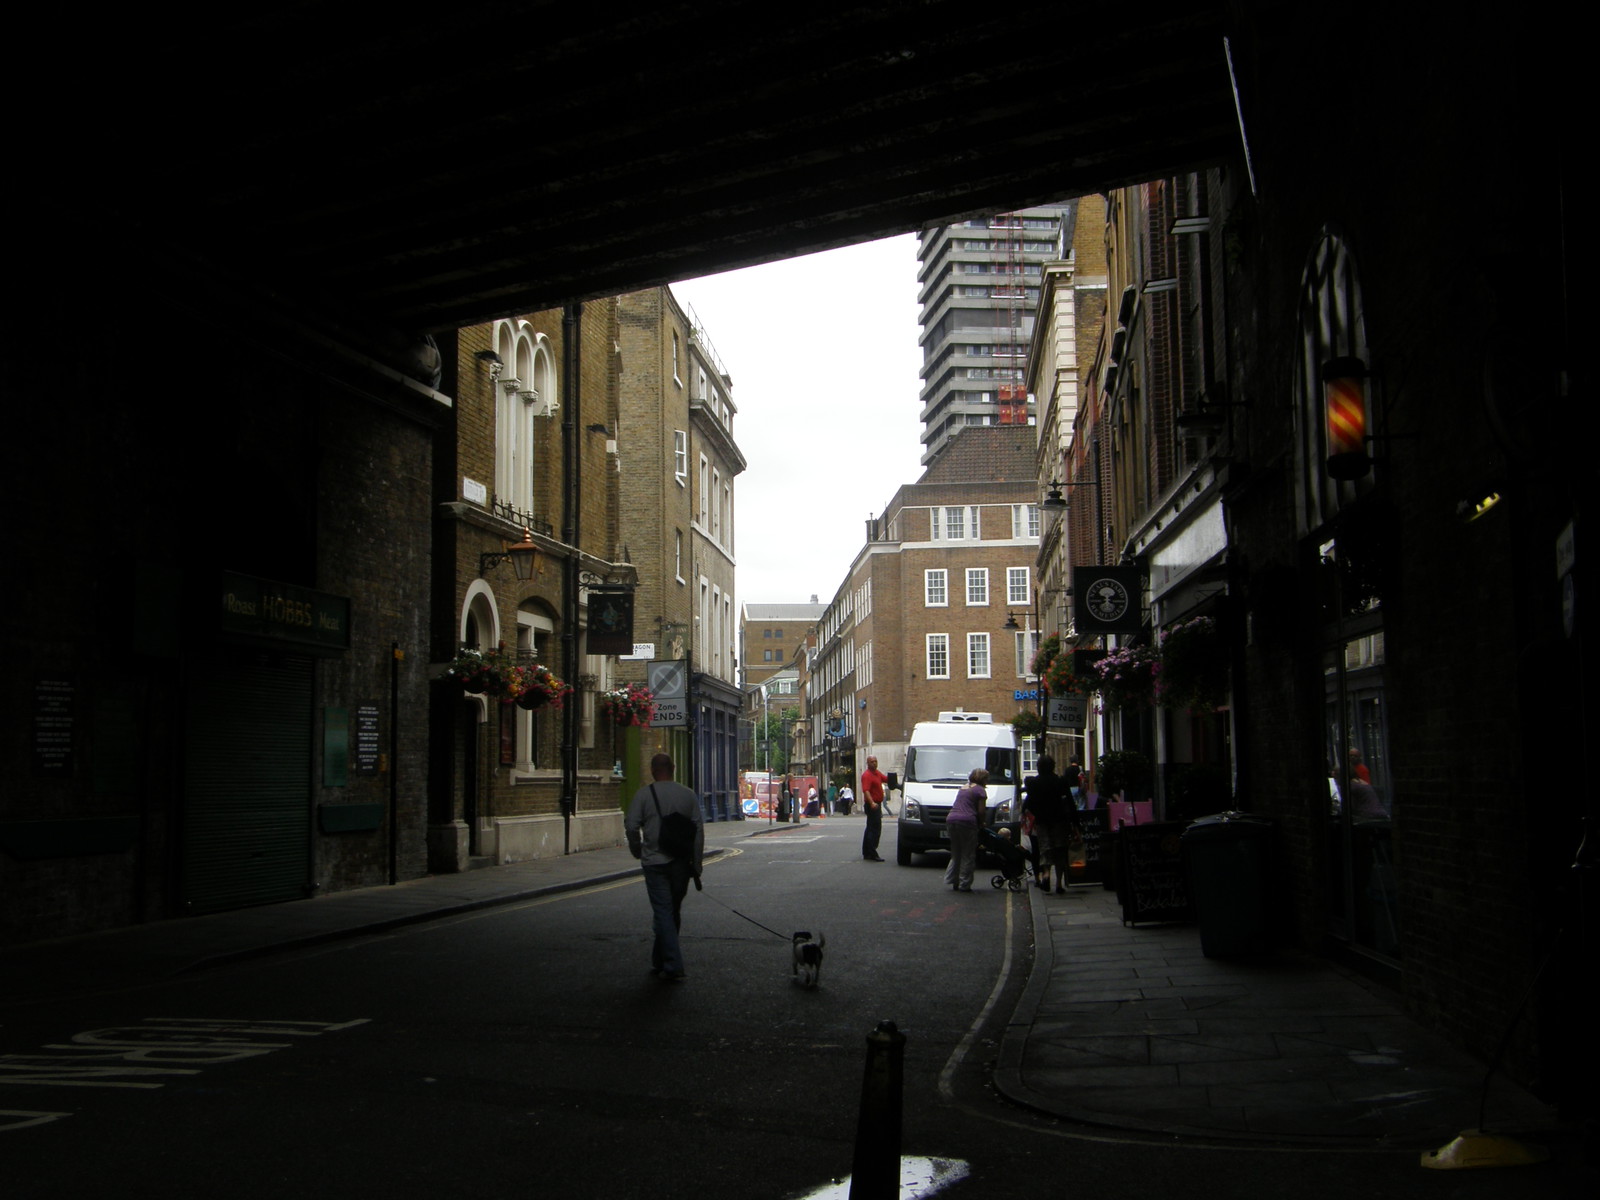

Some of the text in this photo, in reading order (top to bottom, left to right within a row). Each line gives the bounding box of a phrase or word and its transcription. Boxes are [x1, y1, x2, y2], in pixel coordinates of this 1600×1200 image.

[1089, 581, 1125, 598] NEAL'S YARD
[226, 592, 340, 631] Roast HOBBS Meat
[1089, 603, 1124, 619] REMEDIES
[657, 703, 678, 711] Zone
[1057, 703, 1078, 712] Zone
[653, 711, 683, 721] ENDS
[1052, 712, 1082, 723] ENDS
[1135, 888, 1188, 913] Bedales
